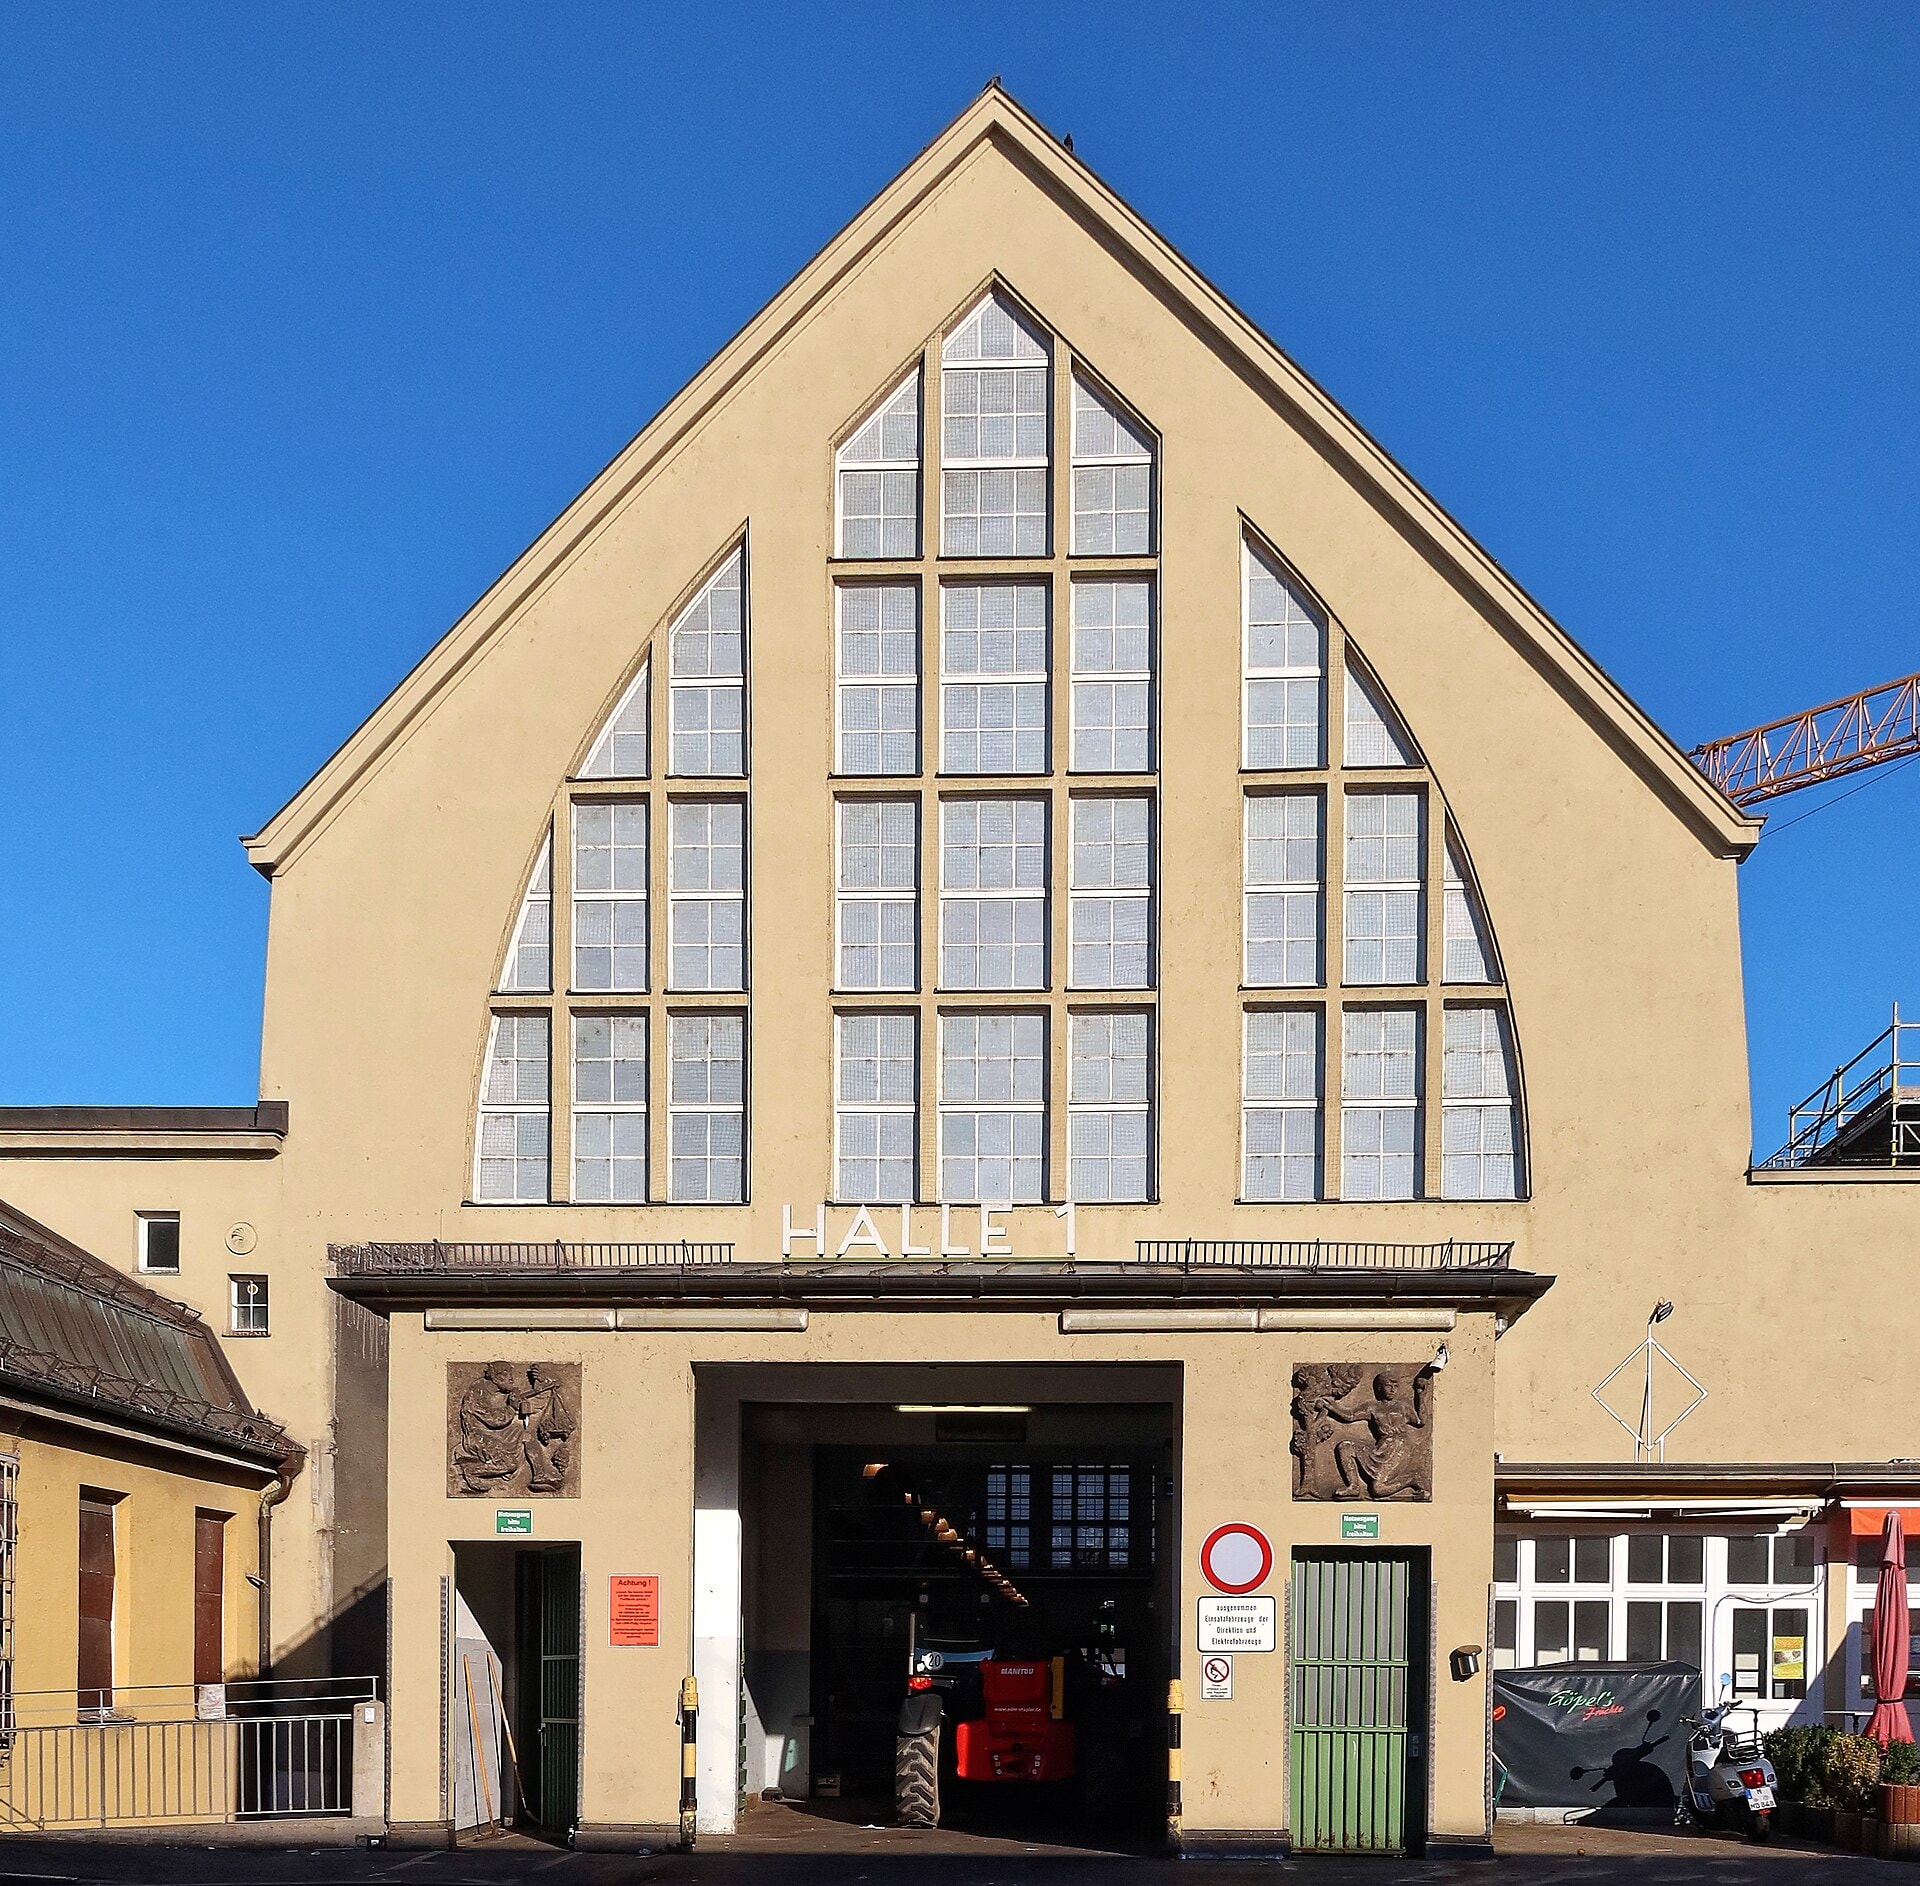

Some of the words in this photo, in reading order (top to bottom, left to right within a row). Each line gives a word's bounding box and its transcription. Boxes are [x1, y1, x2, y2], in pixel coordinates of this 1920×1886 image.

[782, 1203, 1013, 1256] HALLE
[1054, 1203, 1076, 1255] 1
[497, 1511, 531, 1519] Notausgang
[1343, 1515, 1377, 1523] Notausgang
[617, 1579, 647, 1588] Achtung
[1204, 1615, 1254, 1624] Einsatzfahrzeuge
[1216, 1626, 1244, 1634] Direktion
[1245, 1626, 1257, 1634] und
[1211, 1637, 1262, 1646] Elektrofahrzeuge
[928, 1654, 941, 1667] 20
[1000, 1667, 1034, 1675] MANITOU
[1547, 1689, 1616, 1714] Göpel's
